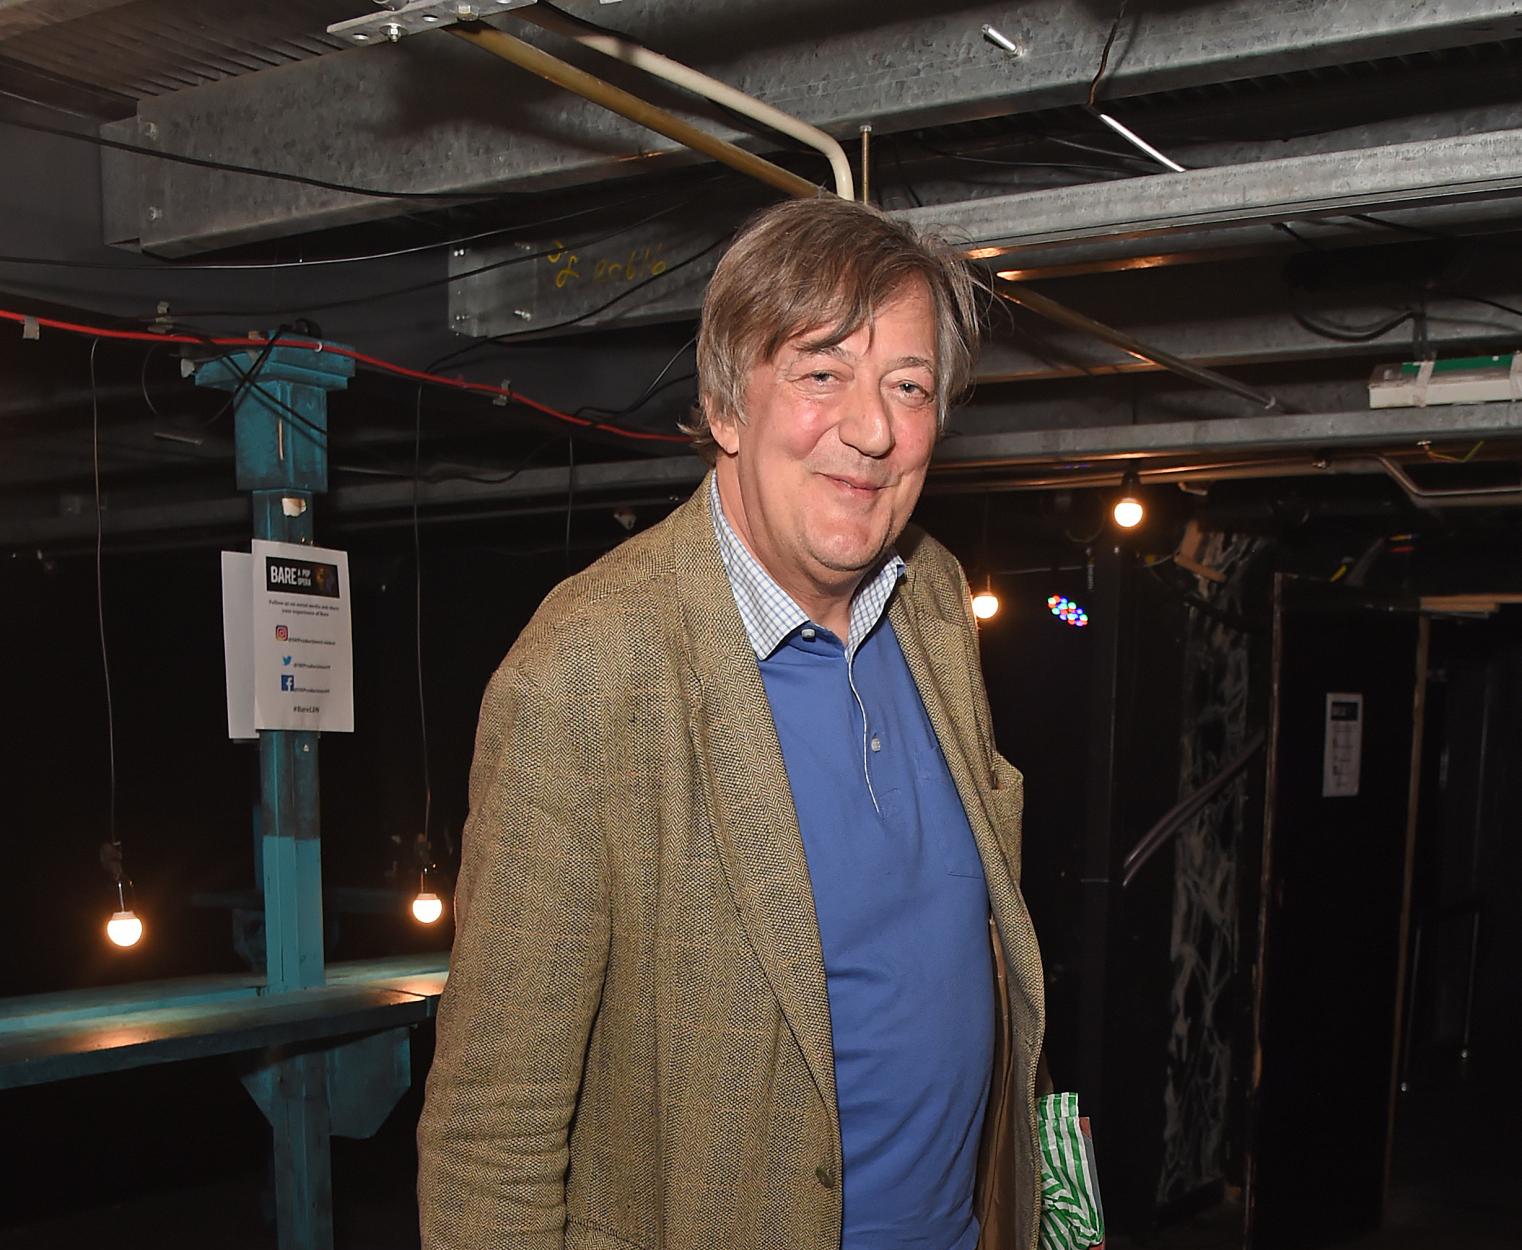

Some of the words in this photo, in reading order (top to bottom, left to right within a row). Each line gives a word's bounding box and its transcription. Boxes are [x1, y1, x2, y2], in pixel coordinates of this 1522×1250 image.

[270, 566, 297, 585] BARE
[297, 568, 301, 576] A
[302, 568, 311, 577] POP
